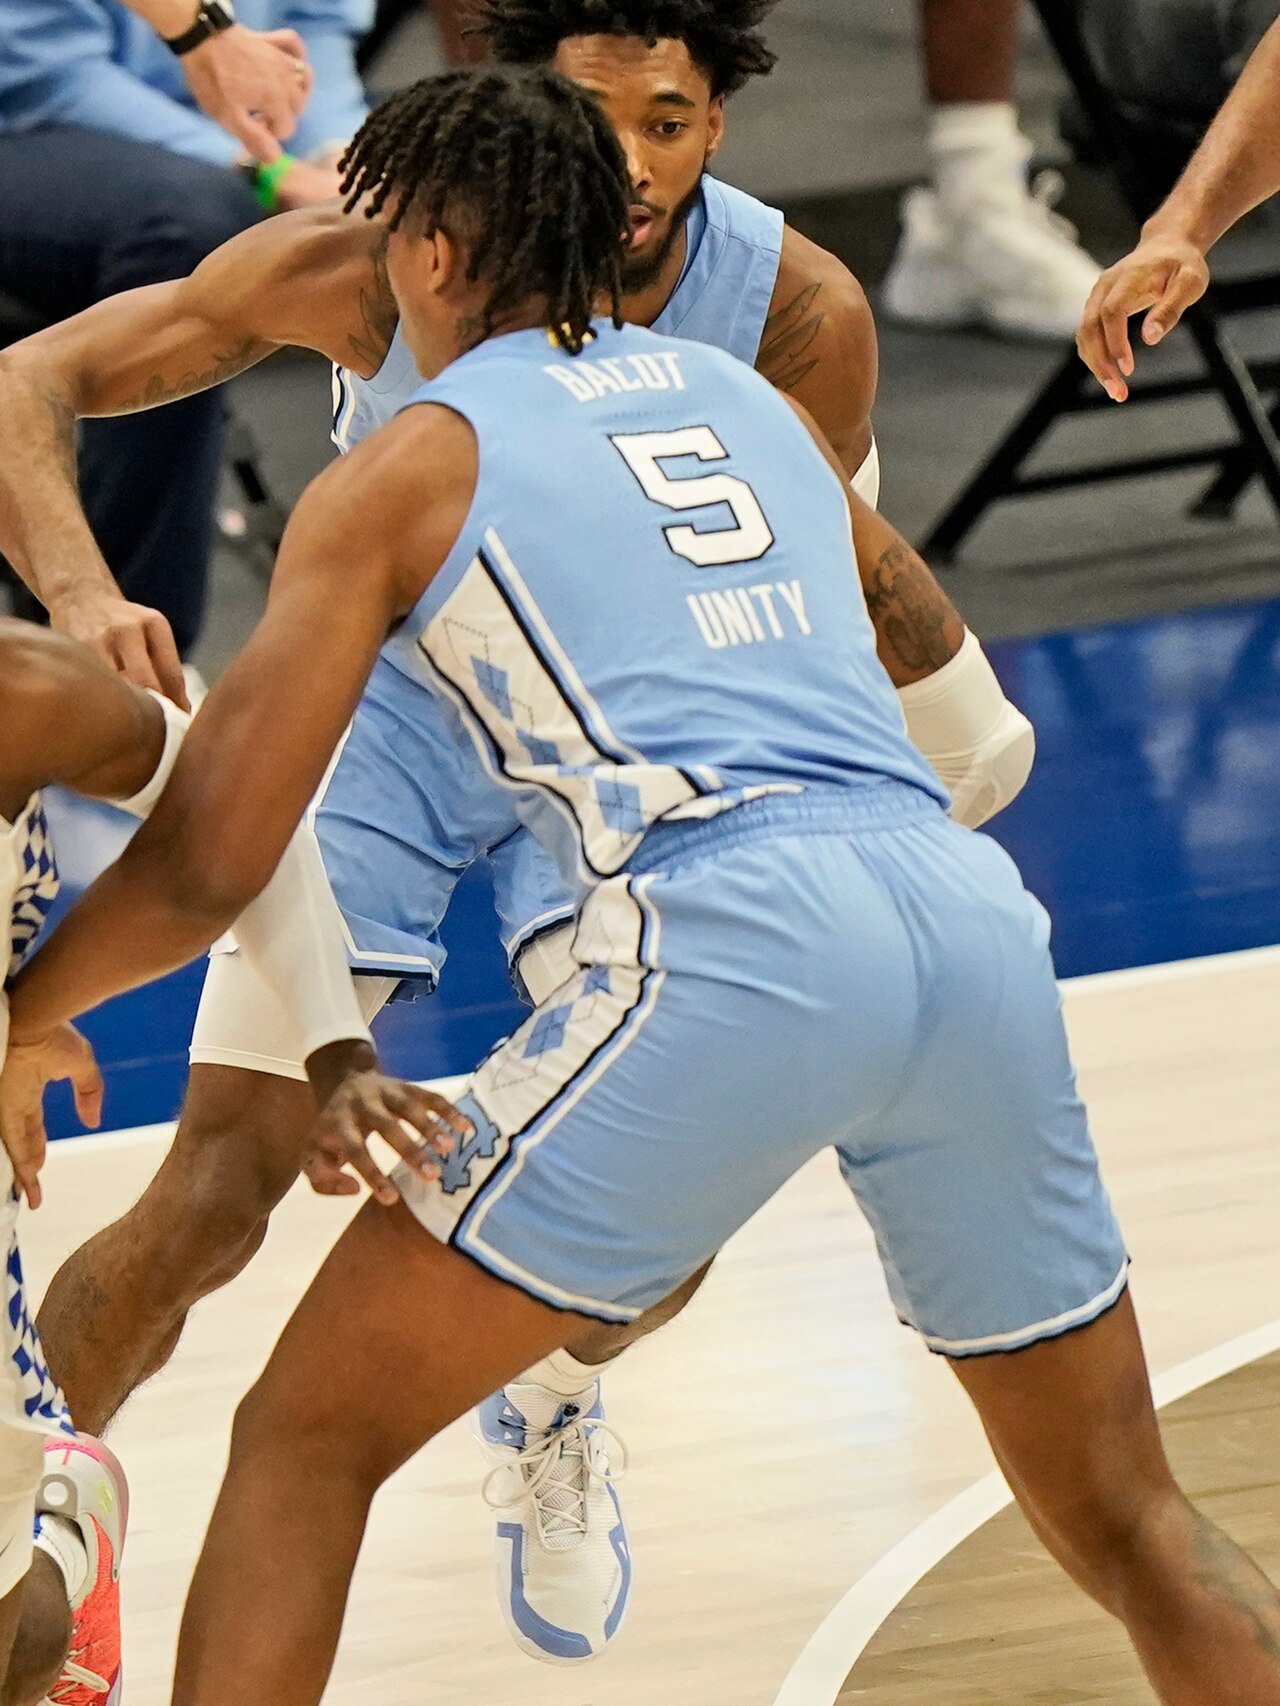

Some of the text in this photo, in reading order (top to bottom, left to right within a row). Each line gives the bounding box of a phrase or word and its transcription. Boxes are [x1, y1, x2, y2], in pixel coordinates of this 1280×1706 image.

[542, 351, 686, 403] BACOT
[607, 424, 775, 568] 5
[685, 579, 812, 649] UNITY
